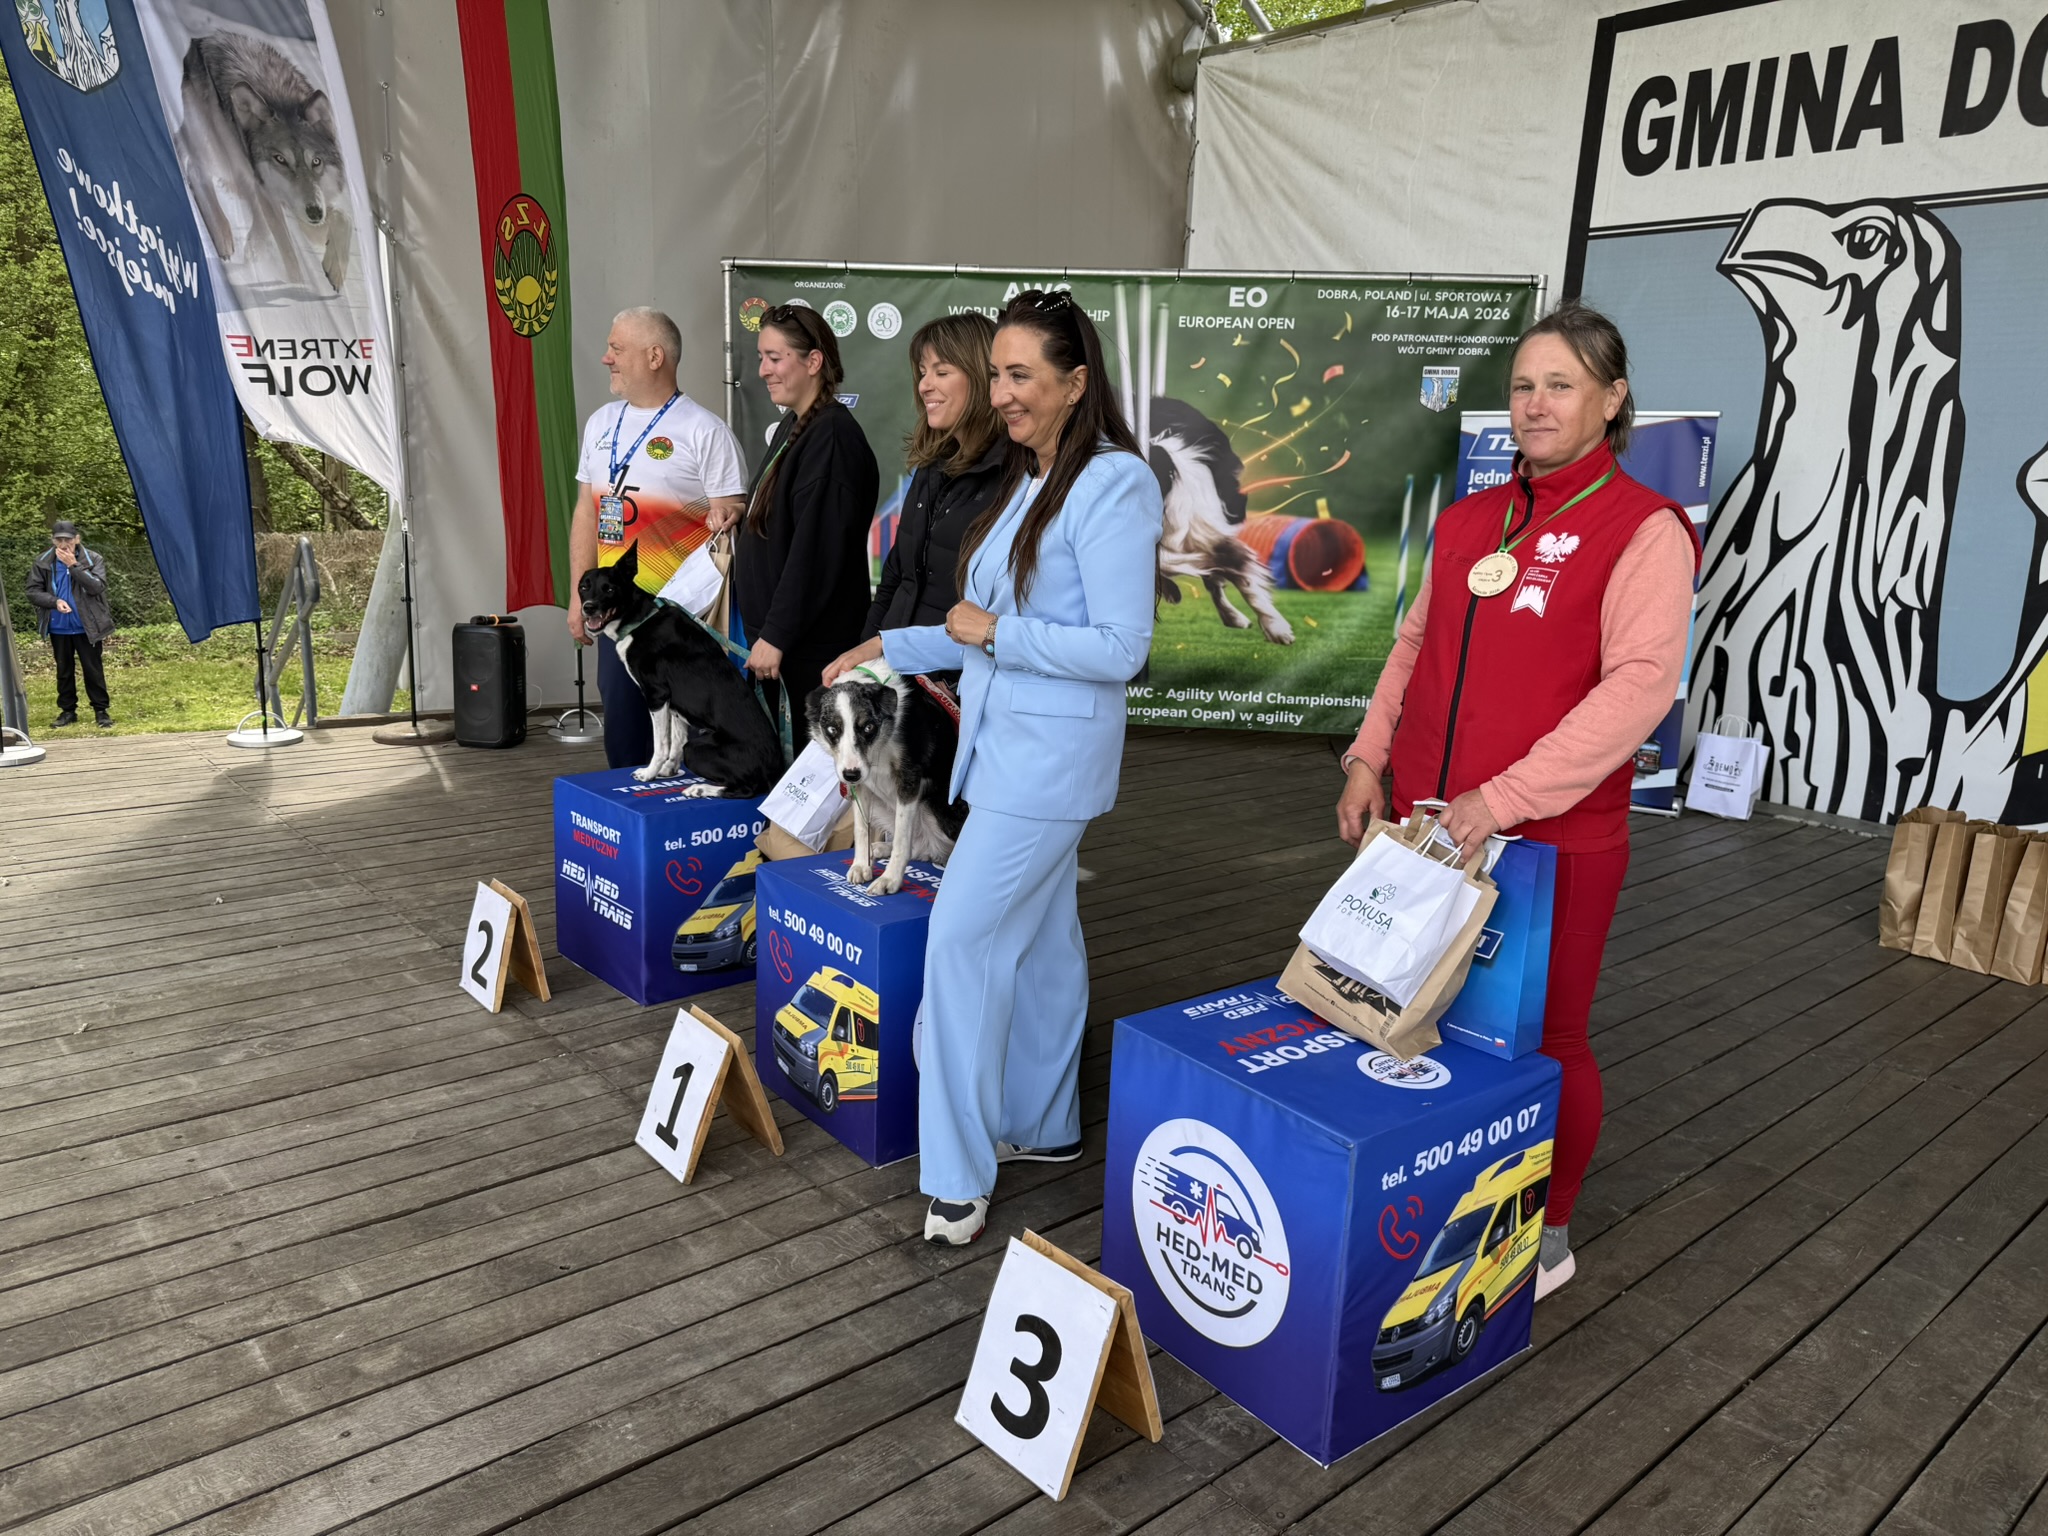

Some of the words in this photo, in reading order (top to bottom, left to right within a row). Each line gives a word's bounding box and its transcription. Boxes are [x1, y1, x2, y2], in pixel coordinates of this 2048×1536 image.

[1621, 36, 1904, 177] GMINA
[794, 281, 847, 289] ORGANIZATOR:
[1229, 287, 1268, 307] EO
[1317, 289, 1361, 301] DOBRA,
[1364, 290, 1412, 301] POLAND
[1419, 291, 1432, 301] ul.
[1435, 292, 1502, 303] SPORTOWA
[1505, 293, 1512, 303] 7
[1178, 316, 1253, 329] EUROPEAN
[1257, 317, 1295, 330] OPEN
[1386, 305, 1420, 318] 16-17
[1424, 306, 1469, 320] MAJA
[1474, 307, 1511, 321] 2026
[1371, 333, 1390, 342] POD
[1392, 334, 1452, 343] PATRONATEM
[1454, 335, 1519, 344] HONOROWYM
[1398, 345, 1425, 355] WÓJT
[1426, 346, 1456, 356] GMINY
[1458, 347, 1491, 356] DOBRA
[1698, 437, 1711, 488] www.tenzi.pl
[1491, 569, 1503, 582] 3
[1166, 688, 1214, 703] Agility
[1218, 690, 1262, 704] World
[1127, 707, 1187, 720] uropean
[1191, 708, 1236, 722] Open)
[1239, 712, 1253, 721] w
[1256, 711, 1304, 725] agility
[570, 811, 621, 845] TRANSPORT
[664, 838, 687, 852] tel.
[691, 828, 723, 847] 500
[727, 823, 748, 840] 49
[573, 829, 619, 860] MEDYCZNY
[562, 858, 586, 882] HED
[594, 875, 620, 900] MED
[592, 897, 633, 931] TRANS
[1336, 904, 1353, 916] FOR
[1355, 915, 1387, 936] HEALTH
[1341, 894, 1393, 930] POKUSA
[768, 905, 782, 924] tel.
[784, 910, 807, 936] 500
[809, 924, 825, 946] 49
[827, 932, 843, 956] 00
[845, 942, 863, 965] 07
[471, 919, 493, 990] 2
[655, 1062, 695, 1152] 1
[1381, 1165, 1407, 1190] tel.
[1413, 1140, 1453, 1177] 500
[1457, 1128, 1483, 1157] 49
[1488, 1117, 1512, 1146] 00
[1517, 1103, 1542, 1135] 07
[1156, 1222, 1263, 1295] HED-MED
[1181, 1259, 1236, 1302] TRANS
[991, 1314, 1062, 1440] 3
